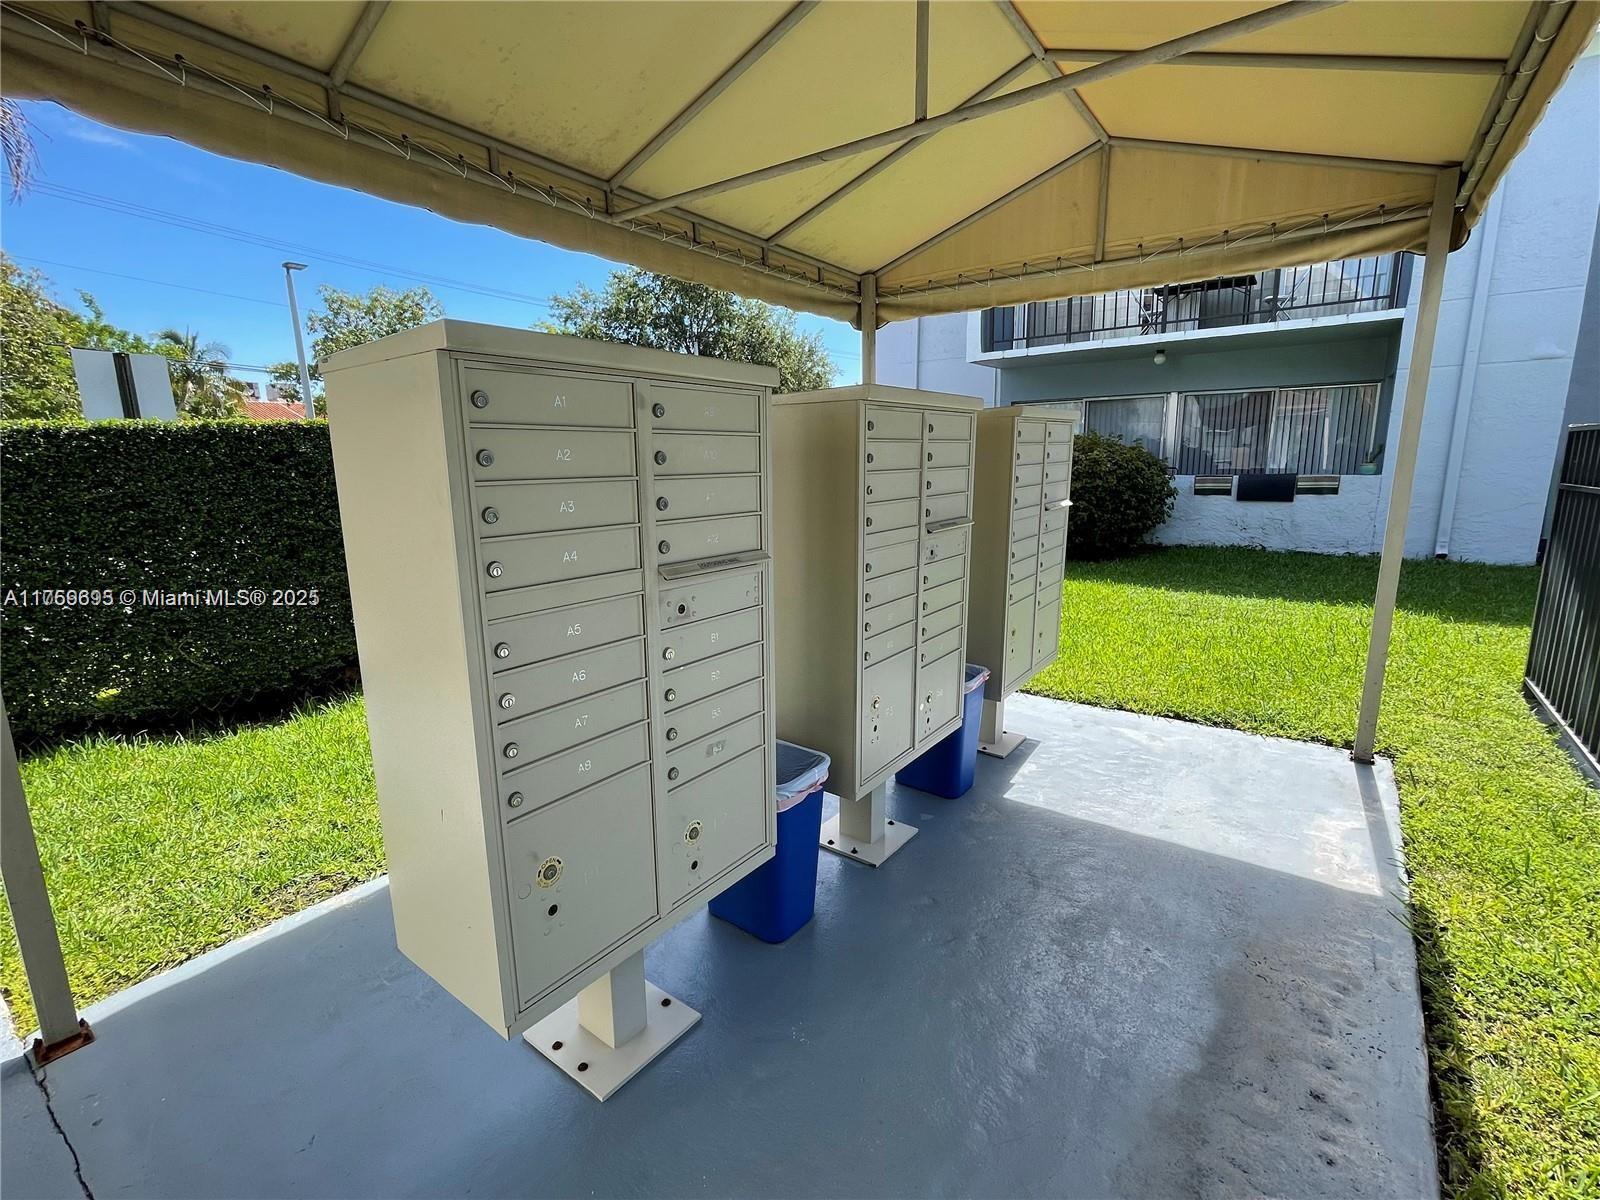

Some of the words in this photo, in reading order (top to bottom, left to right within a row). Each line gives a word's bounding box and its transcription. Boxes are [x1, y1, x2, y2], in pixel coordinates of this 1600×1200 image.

[553, 395, 567, 408] A1
[556, 448, 572, 461] A2
[559, 500, 575, 513] A3
[562, 550, 578, 563] A4
[566, 623, 582, 637] A5
[571, 669, 587, 683] A6
[574, 715, 588, 729] A7
[577, 760, 592, 774] A8
